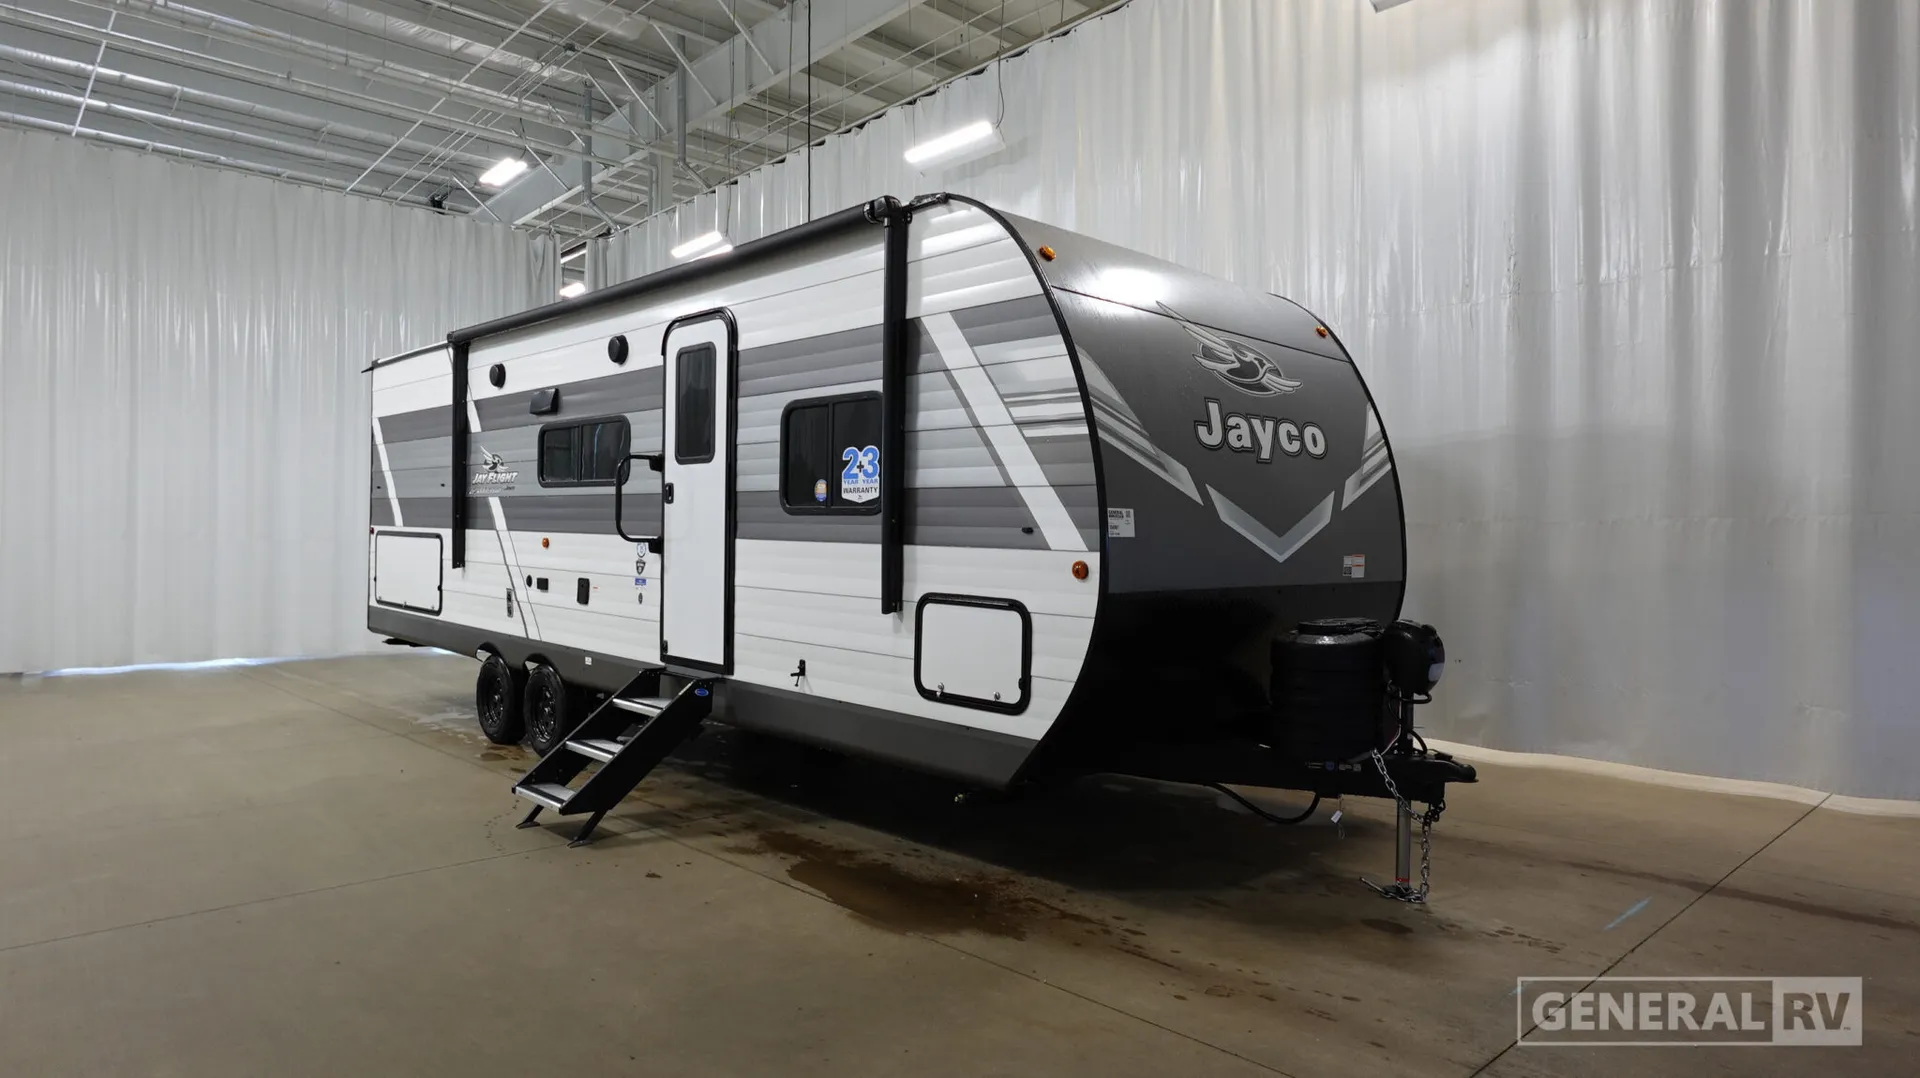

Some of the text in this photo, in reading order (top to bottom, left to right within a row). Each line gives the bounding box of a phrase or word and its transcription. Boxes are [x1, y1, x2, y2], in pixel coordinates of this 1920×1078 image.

[1195, 398, 1327, 462] Jayco
[472, 472, 518, 484] JAY FLIGHT
[843, 486, 878, 494] WARRANTY
